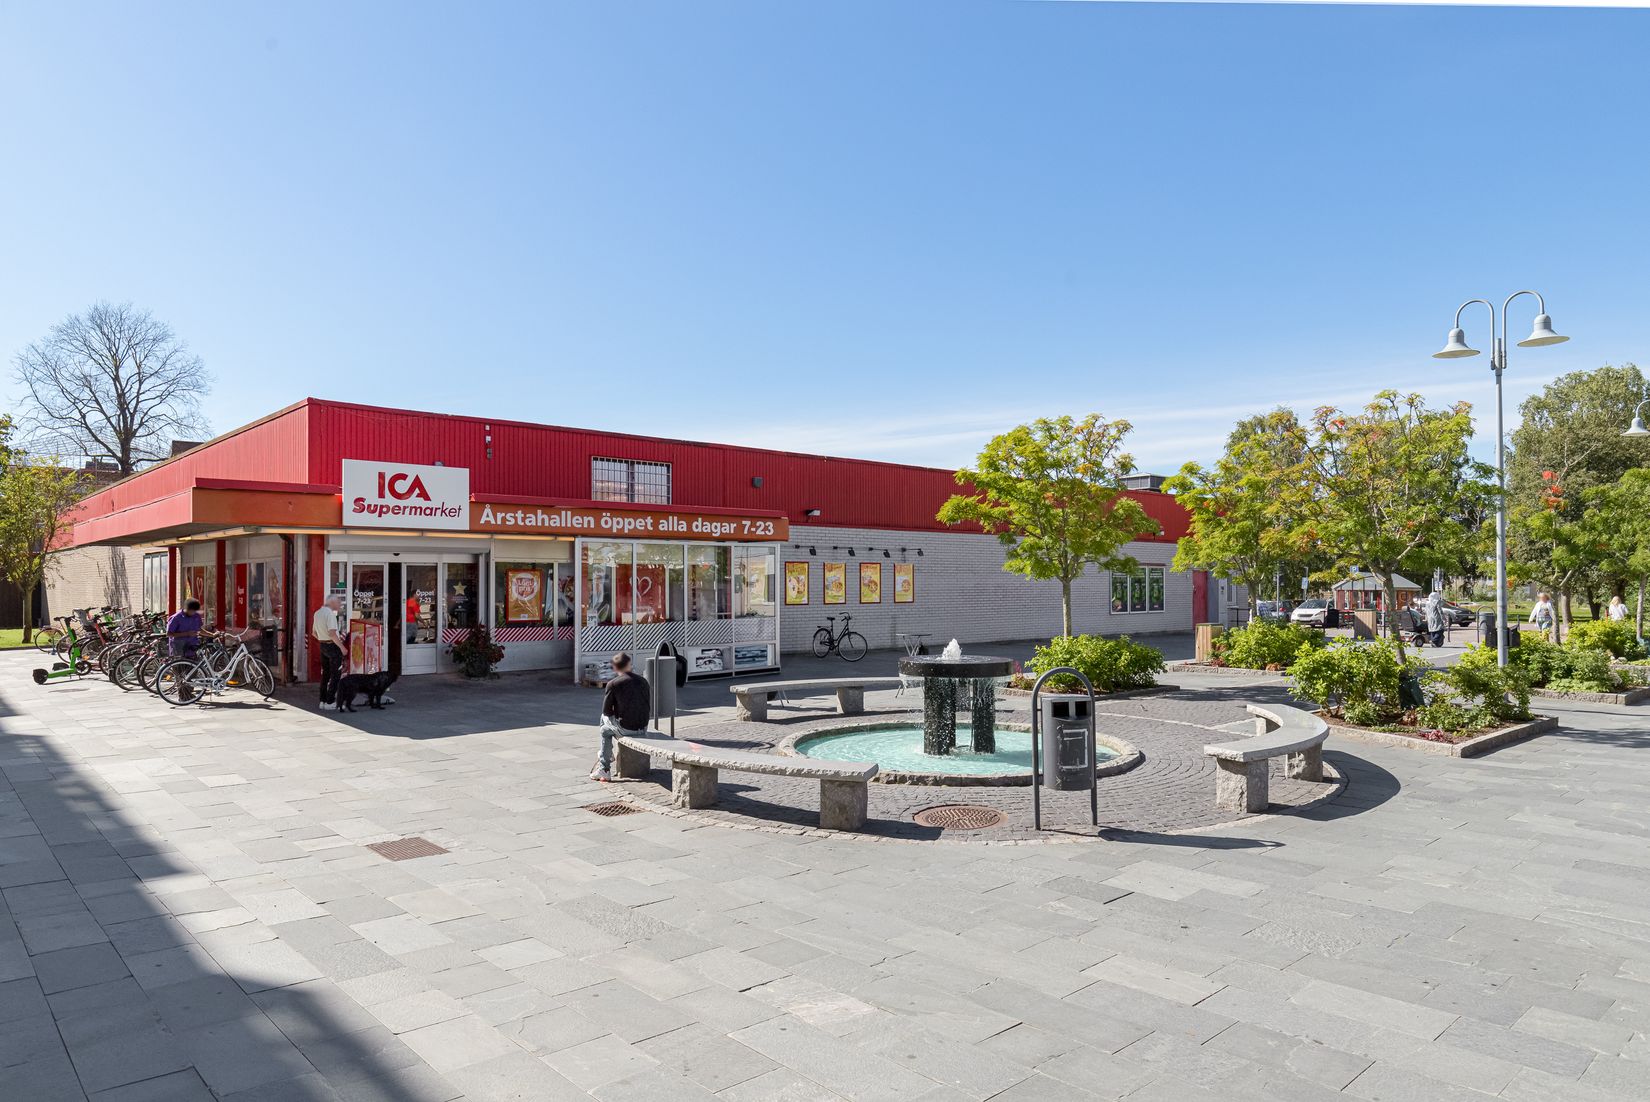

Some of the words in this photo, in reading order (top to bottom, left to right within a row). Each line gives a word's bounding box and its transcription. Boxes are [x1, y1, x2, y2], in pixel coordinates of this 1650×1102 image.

[378, 472, 431, 501] ICA
[352, 497, 462, 518] Supermarket
[480, 503, 595, 529] Årstahallen
[600, 512, 653, 534] öppet
[658, 515, 687, 532] alla
[692, 517, 737, 537] dagar
[741, 520, 775, 536] 7-23
[353, 589, 375, 598] Öppet
[415, 588, 434, 597] Öppet
